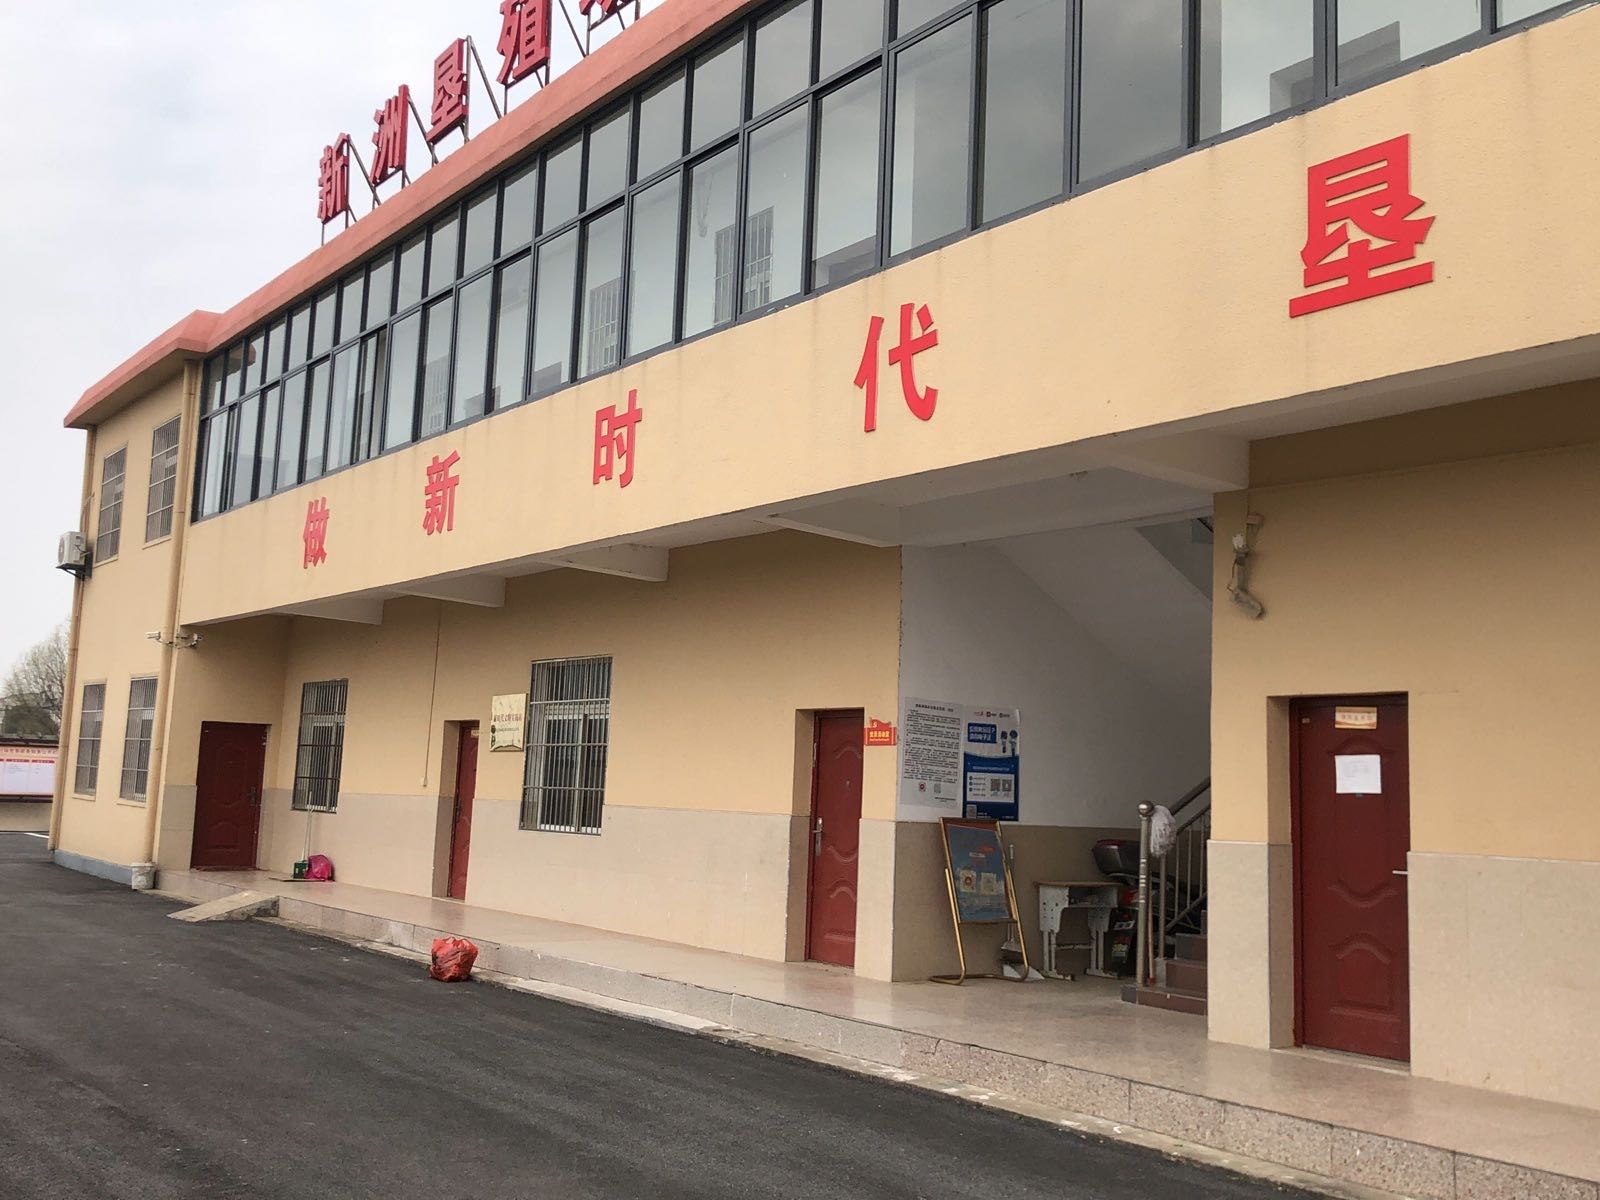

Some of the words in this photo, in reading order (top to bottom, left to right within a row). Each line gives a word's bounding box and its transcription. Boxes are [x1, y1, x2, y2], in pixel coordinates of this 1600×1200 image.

[317, 0, 624, 223] 新洲垦殖
[303, 133, 1436, 569] 做新时代垦
